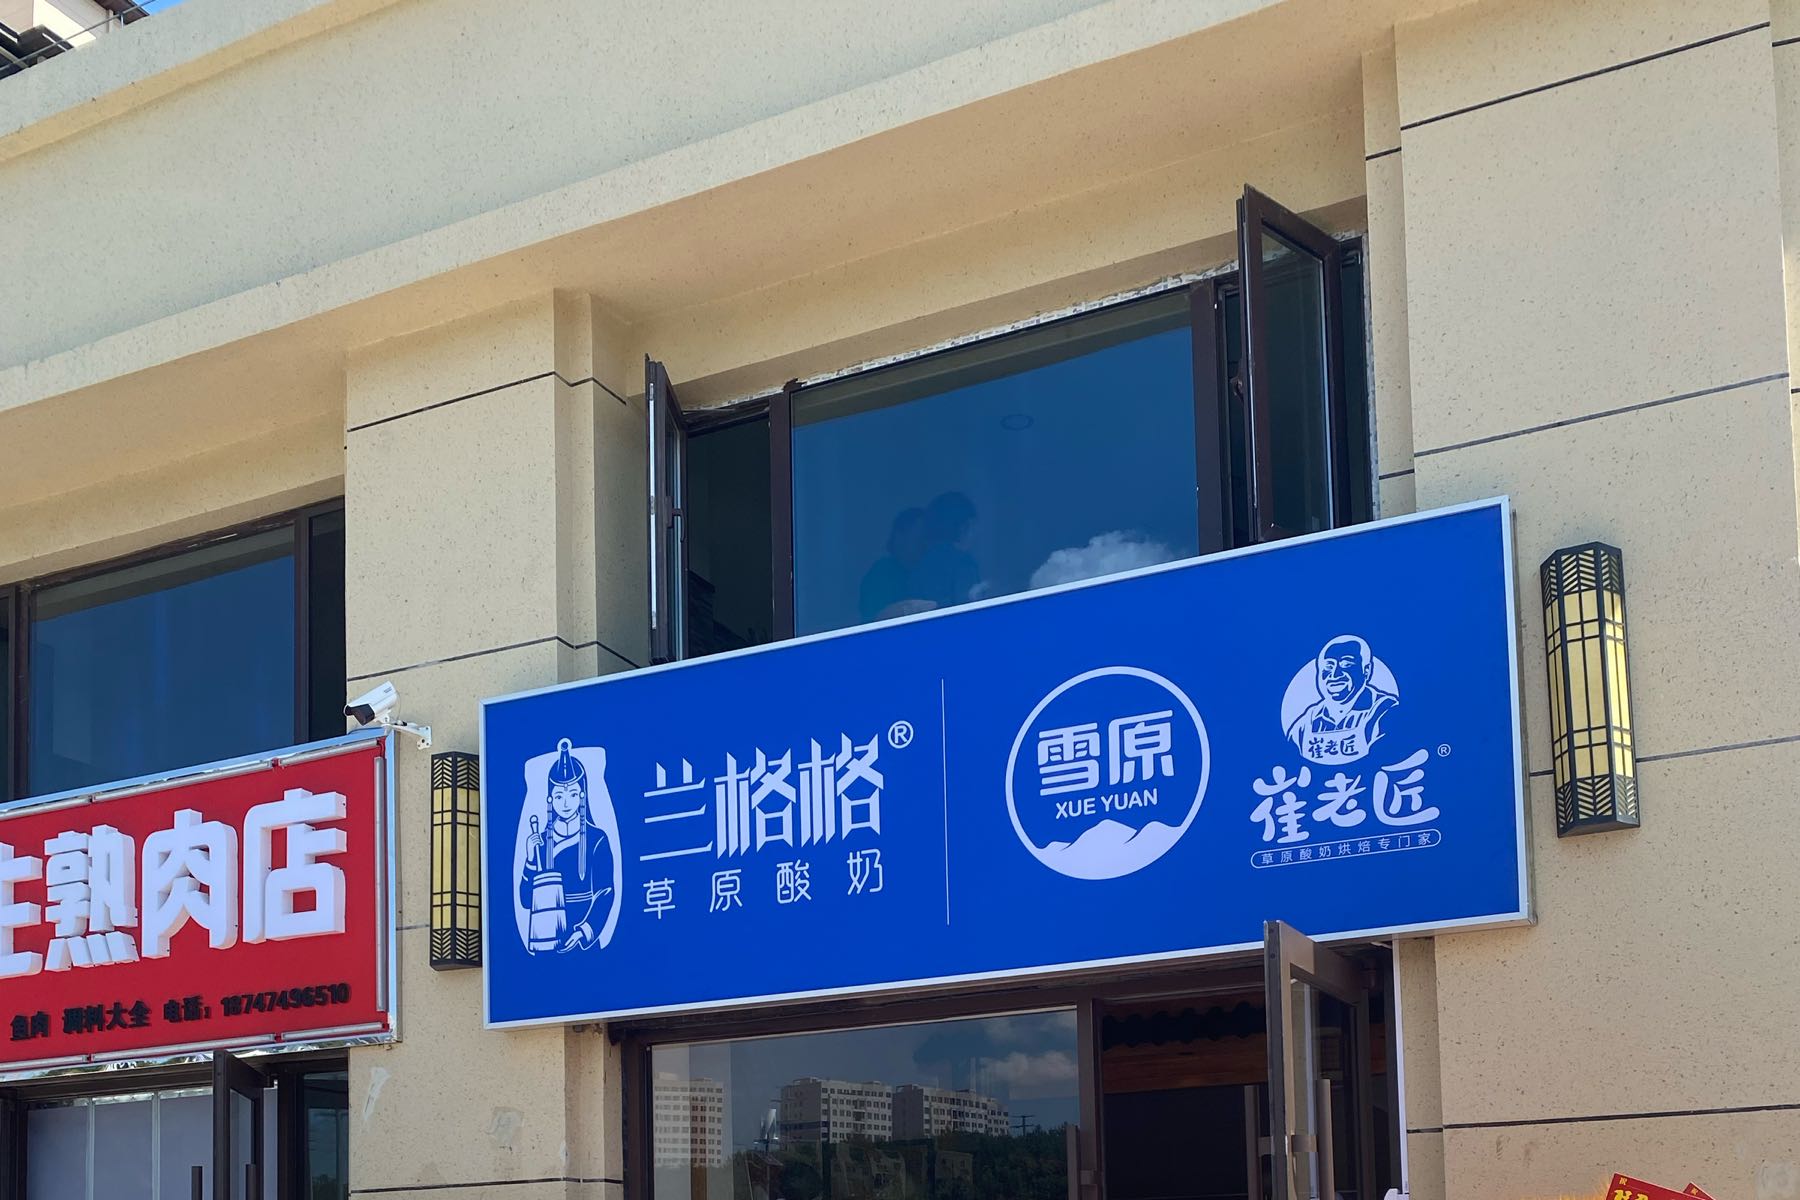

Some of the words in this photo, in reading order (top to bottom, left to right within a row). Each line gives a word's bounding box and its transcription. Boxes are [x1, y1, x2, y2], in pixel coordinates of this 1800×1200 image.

[1037, 709, 1175, 797] 雪原
[1307, 733, 1360, 759] 崔老匠
[639, 731, 885, 862] 兰格格
[1055, 797, 1097, 820] XUE
[1100, 787, 1158, 813] YUAN
[1249, 748, 1441, 844] 崔老匠
[1260, 832, 1432, 866] 草原酸奶烘焙专门家
[642, 847, 884, 920] 草原酸奶
[62, 1000, 152, 1035] 调料大全
